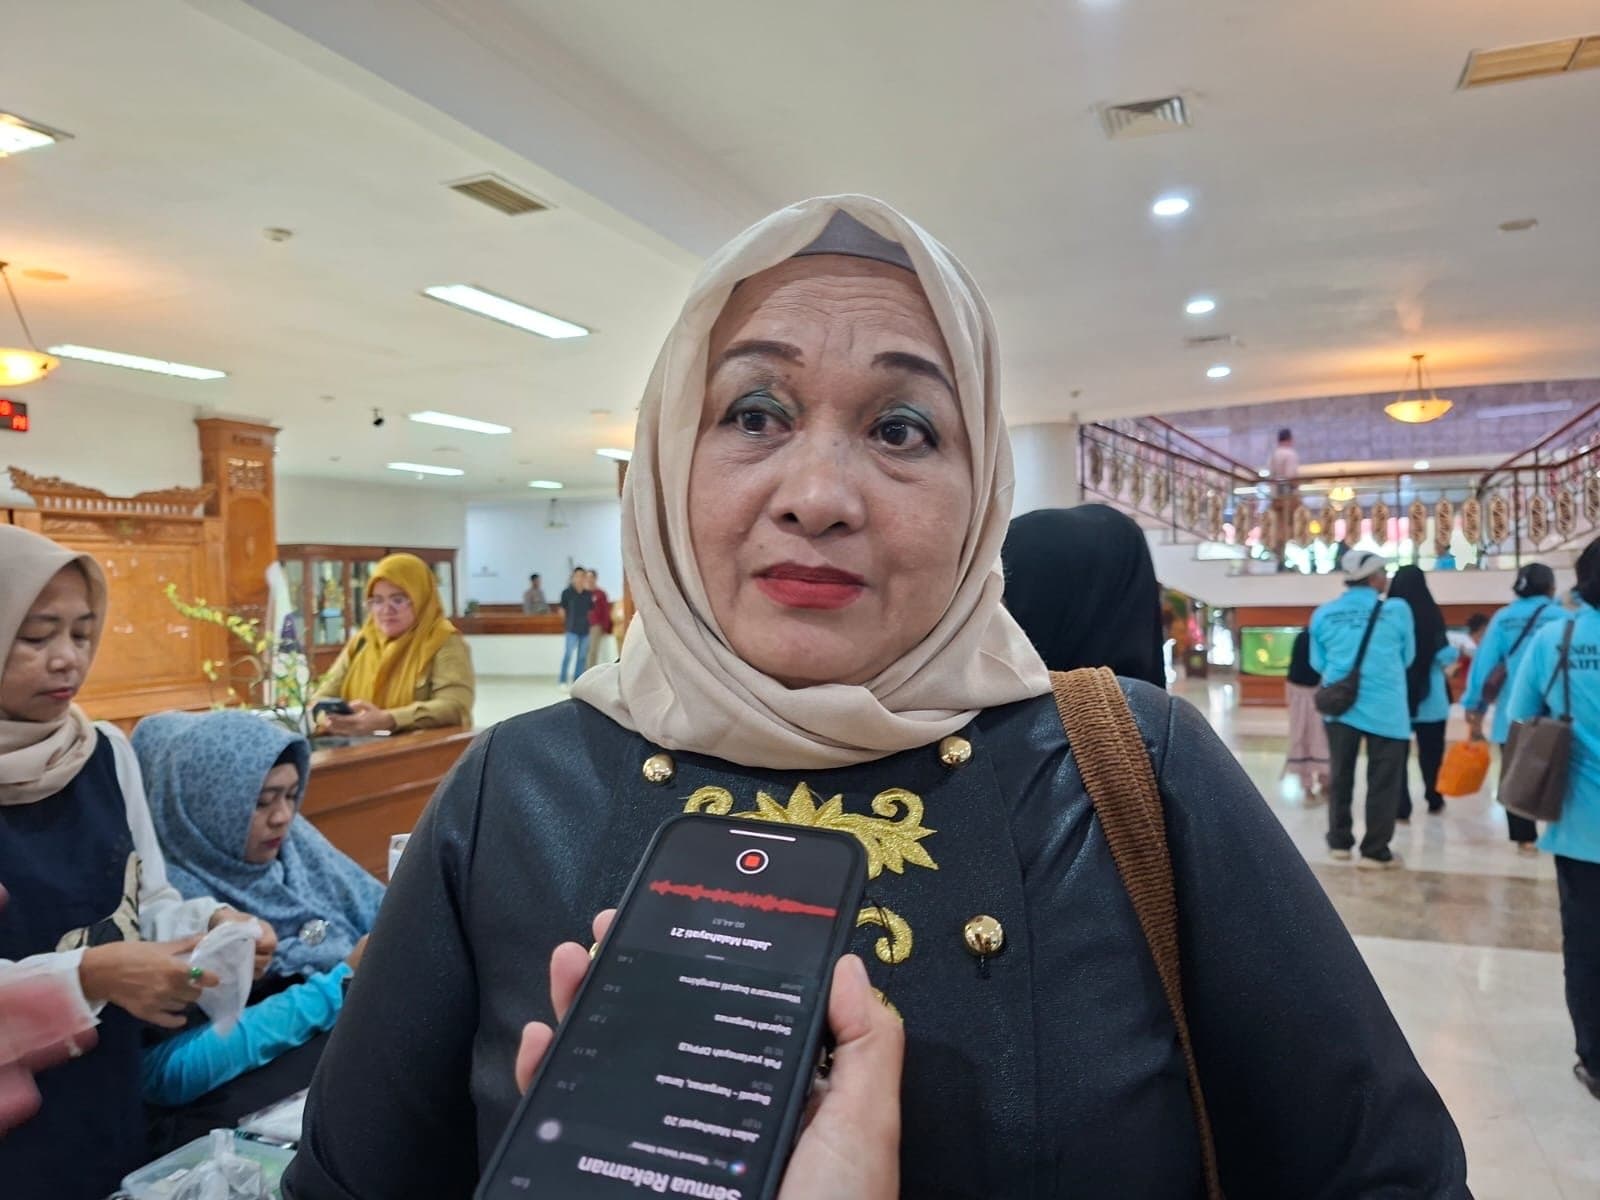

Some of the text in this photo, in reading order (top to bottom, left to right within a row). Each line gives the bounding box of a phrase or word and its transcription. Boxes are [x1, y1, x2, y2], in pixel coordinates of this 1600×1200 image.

[670, 927, 771, 951] Jalan Malahayati 21
[720, 981, 749, 995] bupati
[750, 987, 800, 1004] Wawancara
[756, 1021, 791, 1035] Sejarah
[763, 1057, 781, 1069] Pak
[737, 1089, 771, 1105] Bupati
[663, 1114, 679, 1125] 20
[731, 1129, 759, 1142] Jalan
[577, 1156, 669, 1192] Rekaman
